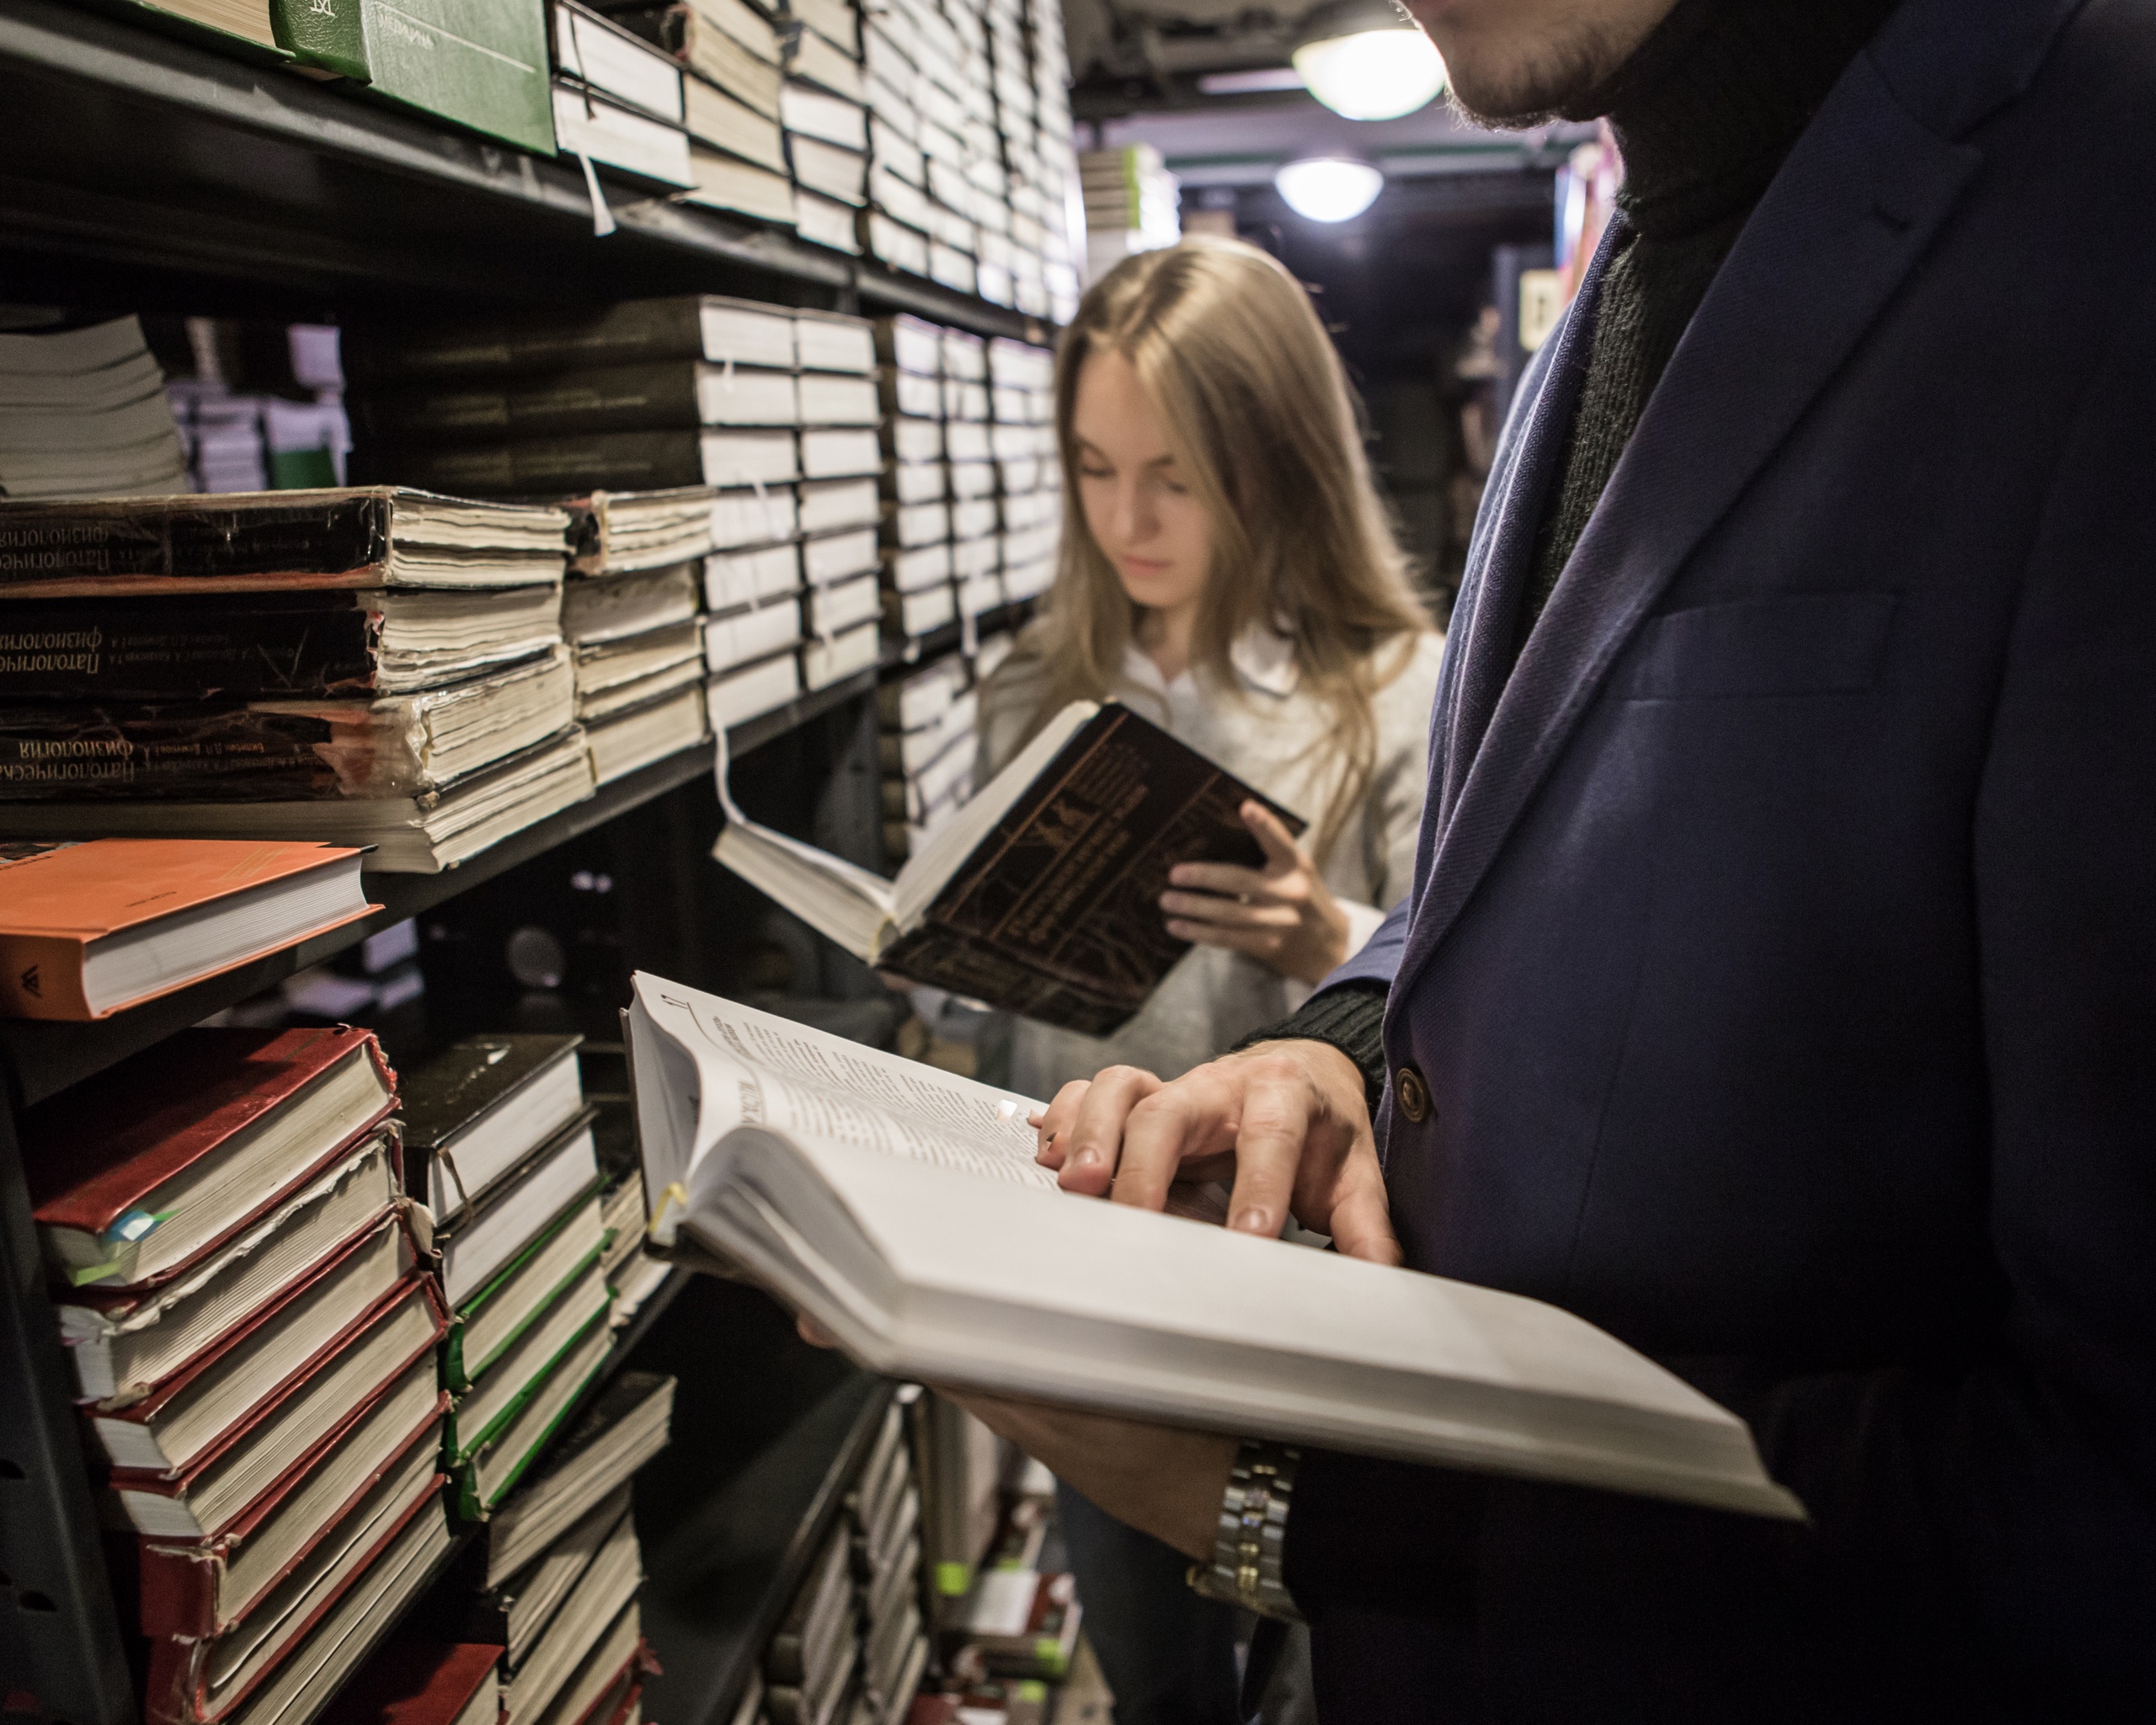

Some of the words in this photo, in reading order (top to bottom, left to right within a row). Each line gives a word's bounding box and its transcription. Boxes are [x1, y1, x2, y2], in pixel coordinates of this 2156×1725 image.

[0, 548, 110, 572] Патологиче
[0, 626, 103, 653] физиологи
[19, 737, 134, 761] физиология
[0, 761, 136, 783] Патологическ
